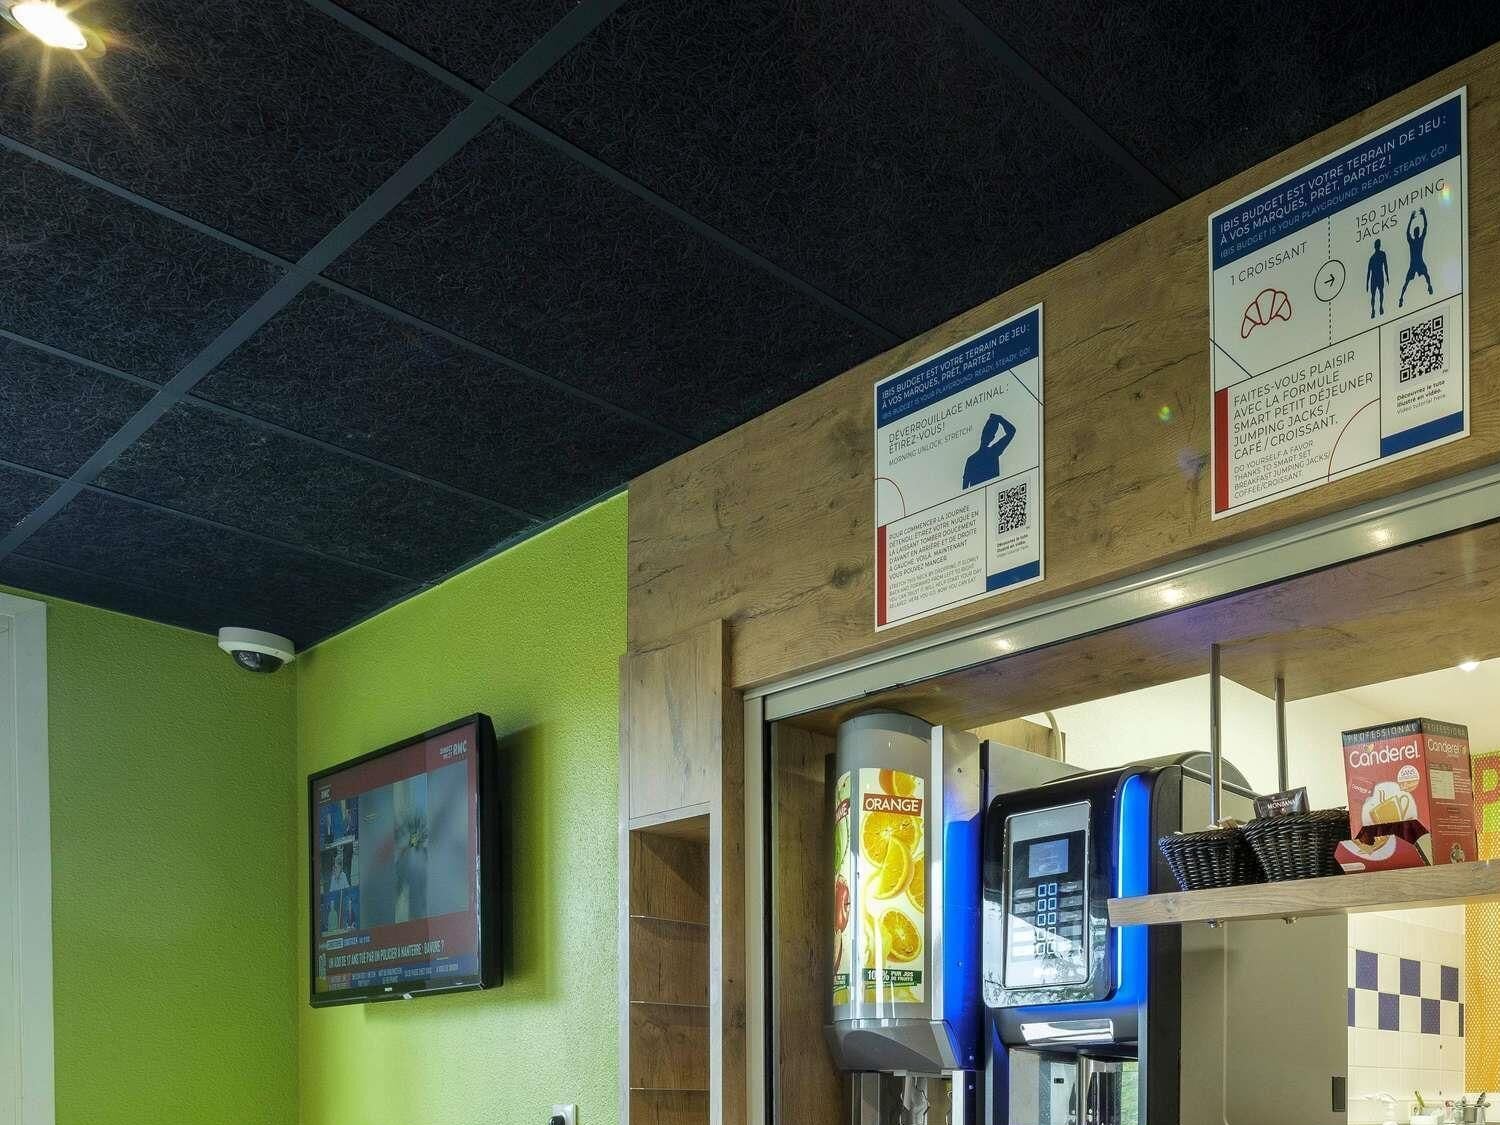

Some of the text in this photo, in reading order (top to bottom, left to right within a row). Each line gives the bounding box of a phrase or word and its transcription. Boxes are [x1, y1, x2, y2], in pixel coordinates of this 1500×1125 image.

[1221, 216, 1239, 233] IBIS
[1242, 194, 1286, 222] BUDGET
[1287, 184, 1305, 200] EST
[1308, 165, 1344, 190] VOTRE
[1347, 139, 1395, 171] TERRAIN
[1399, 129, 1415, 146] DE
[1230, 225, 1250, 240] VOS
[1253, 198, 1307, 230] MARQUES,
[1356, 178, 1445, 229] 150 JUMPING
[1236, 231, 1268, 252] BUDGET
[1278, 216, 1300, 233] YOUR
[1356, 215, 1398, 243] JACKS
[1230, 241, 1307, 286] 1 CROISSANT
[882, 387, 895, 400] IBIS
[896, 373, 924, 392] BUDGET
[926, 366, 938, 379] EST
[940, 354, 963, 373] VOTRE
[965, 338, 997, 360] TERRAIN
[1000, 333, 1010, 344] DE
[1234, 350, 1355, 406] FAITES-VOUS PLAISIR
[889, 394, 901, 406] VOS
[1233, 371, 1340, 420] AVEC LA FORMULE
[1233, 372, 1374, 434] SMART PETIT DÉJEUNER
[889, 402, 963, 443] DÉVERROUILLAGE
[1233, 420, 1285, 447] JUMPING
[1233, 439, 1262, 460] CAFÉ
[1234, 468, 1260, 482] THANKS
[1273, 454, 1296, 469] SMART
[1234, 473, 1271, 491] BREAKFAST
[1346, 723, 1417, 742] PROFESSIONAL
[1349, 741, 1420, 768] Canderel
[865, 798, 919, 812] ORANGE
